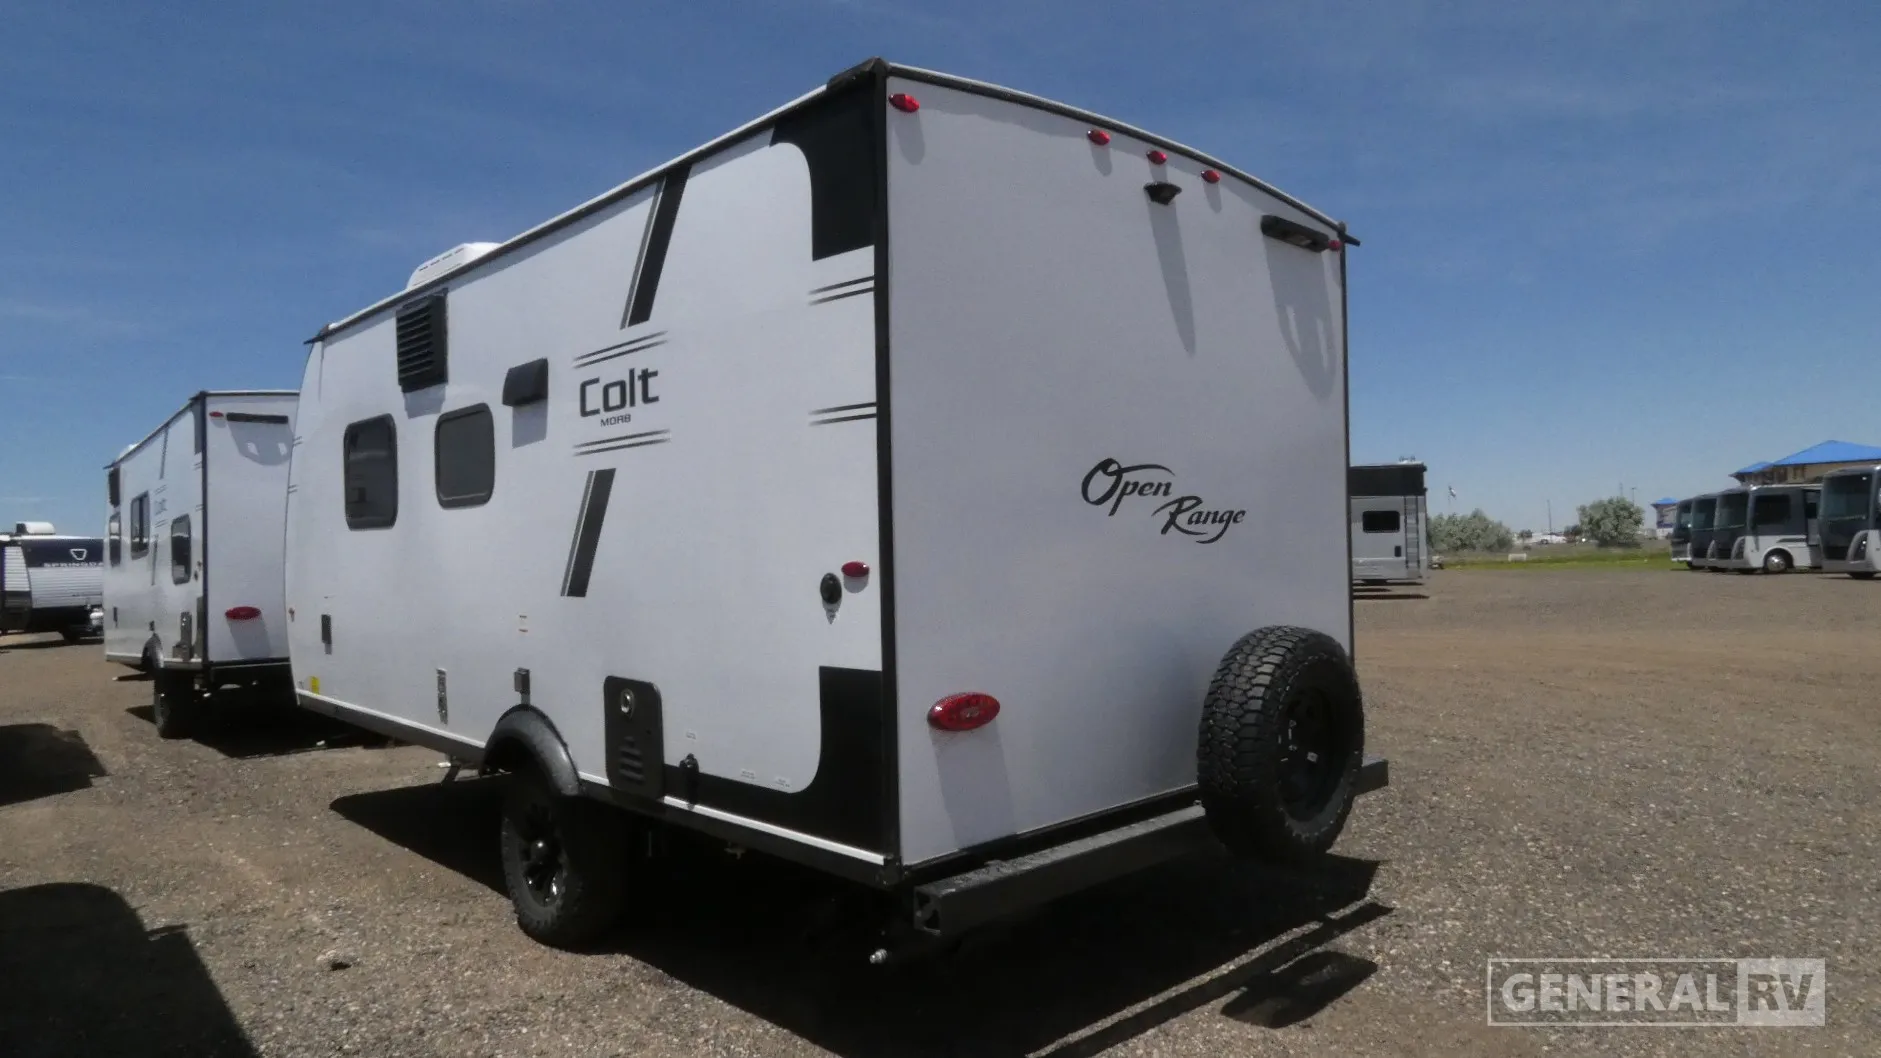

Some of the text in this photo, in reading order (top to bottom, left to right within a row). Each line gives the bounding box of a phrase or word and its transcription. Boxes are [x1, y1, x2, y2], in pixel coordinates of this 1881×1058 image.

[580, 367, 660, 417] Colt
[1081, 458, 1176, 516] Open
[1151, 495, 1246, 544] Range
